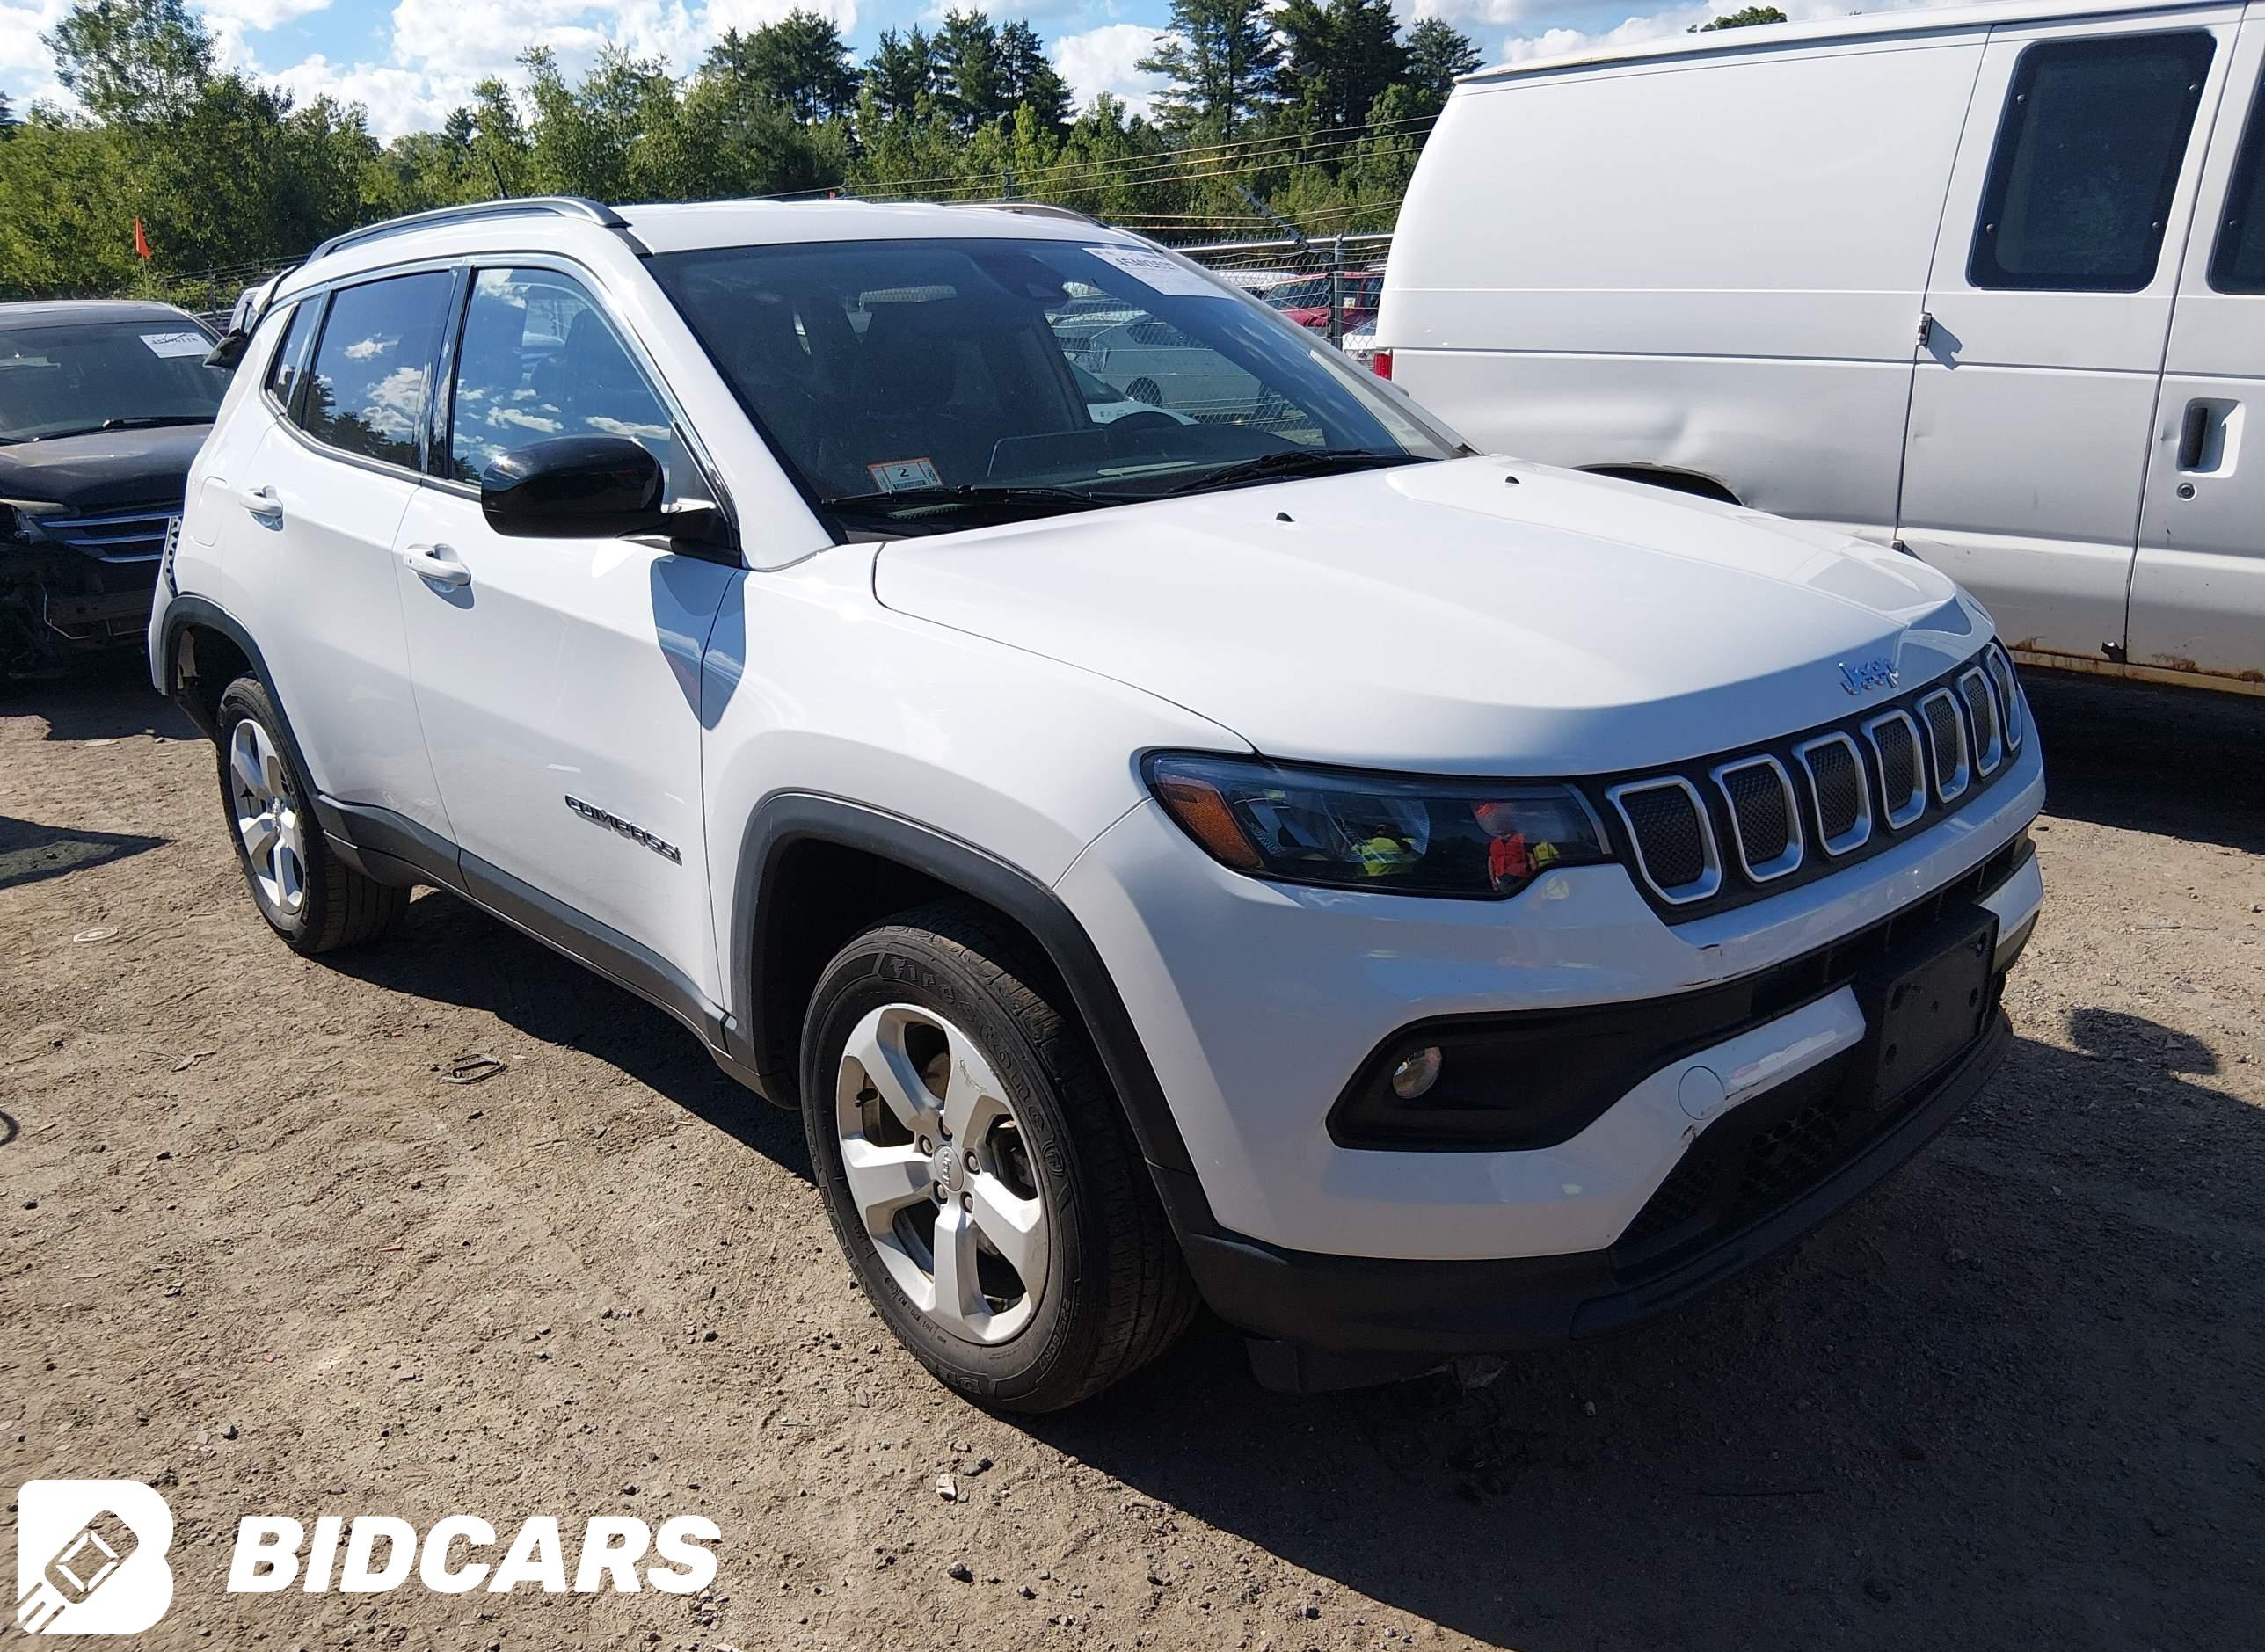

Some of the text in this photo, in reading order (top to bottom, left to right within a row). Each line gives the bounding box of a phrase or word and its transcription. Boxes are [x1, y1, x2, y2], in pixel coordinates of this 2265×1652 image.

[898, 468, 910, 477] 2
[1838, 661, 1899, 695] Jeep
[564, 793, 682, 865] COMPASS
